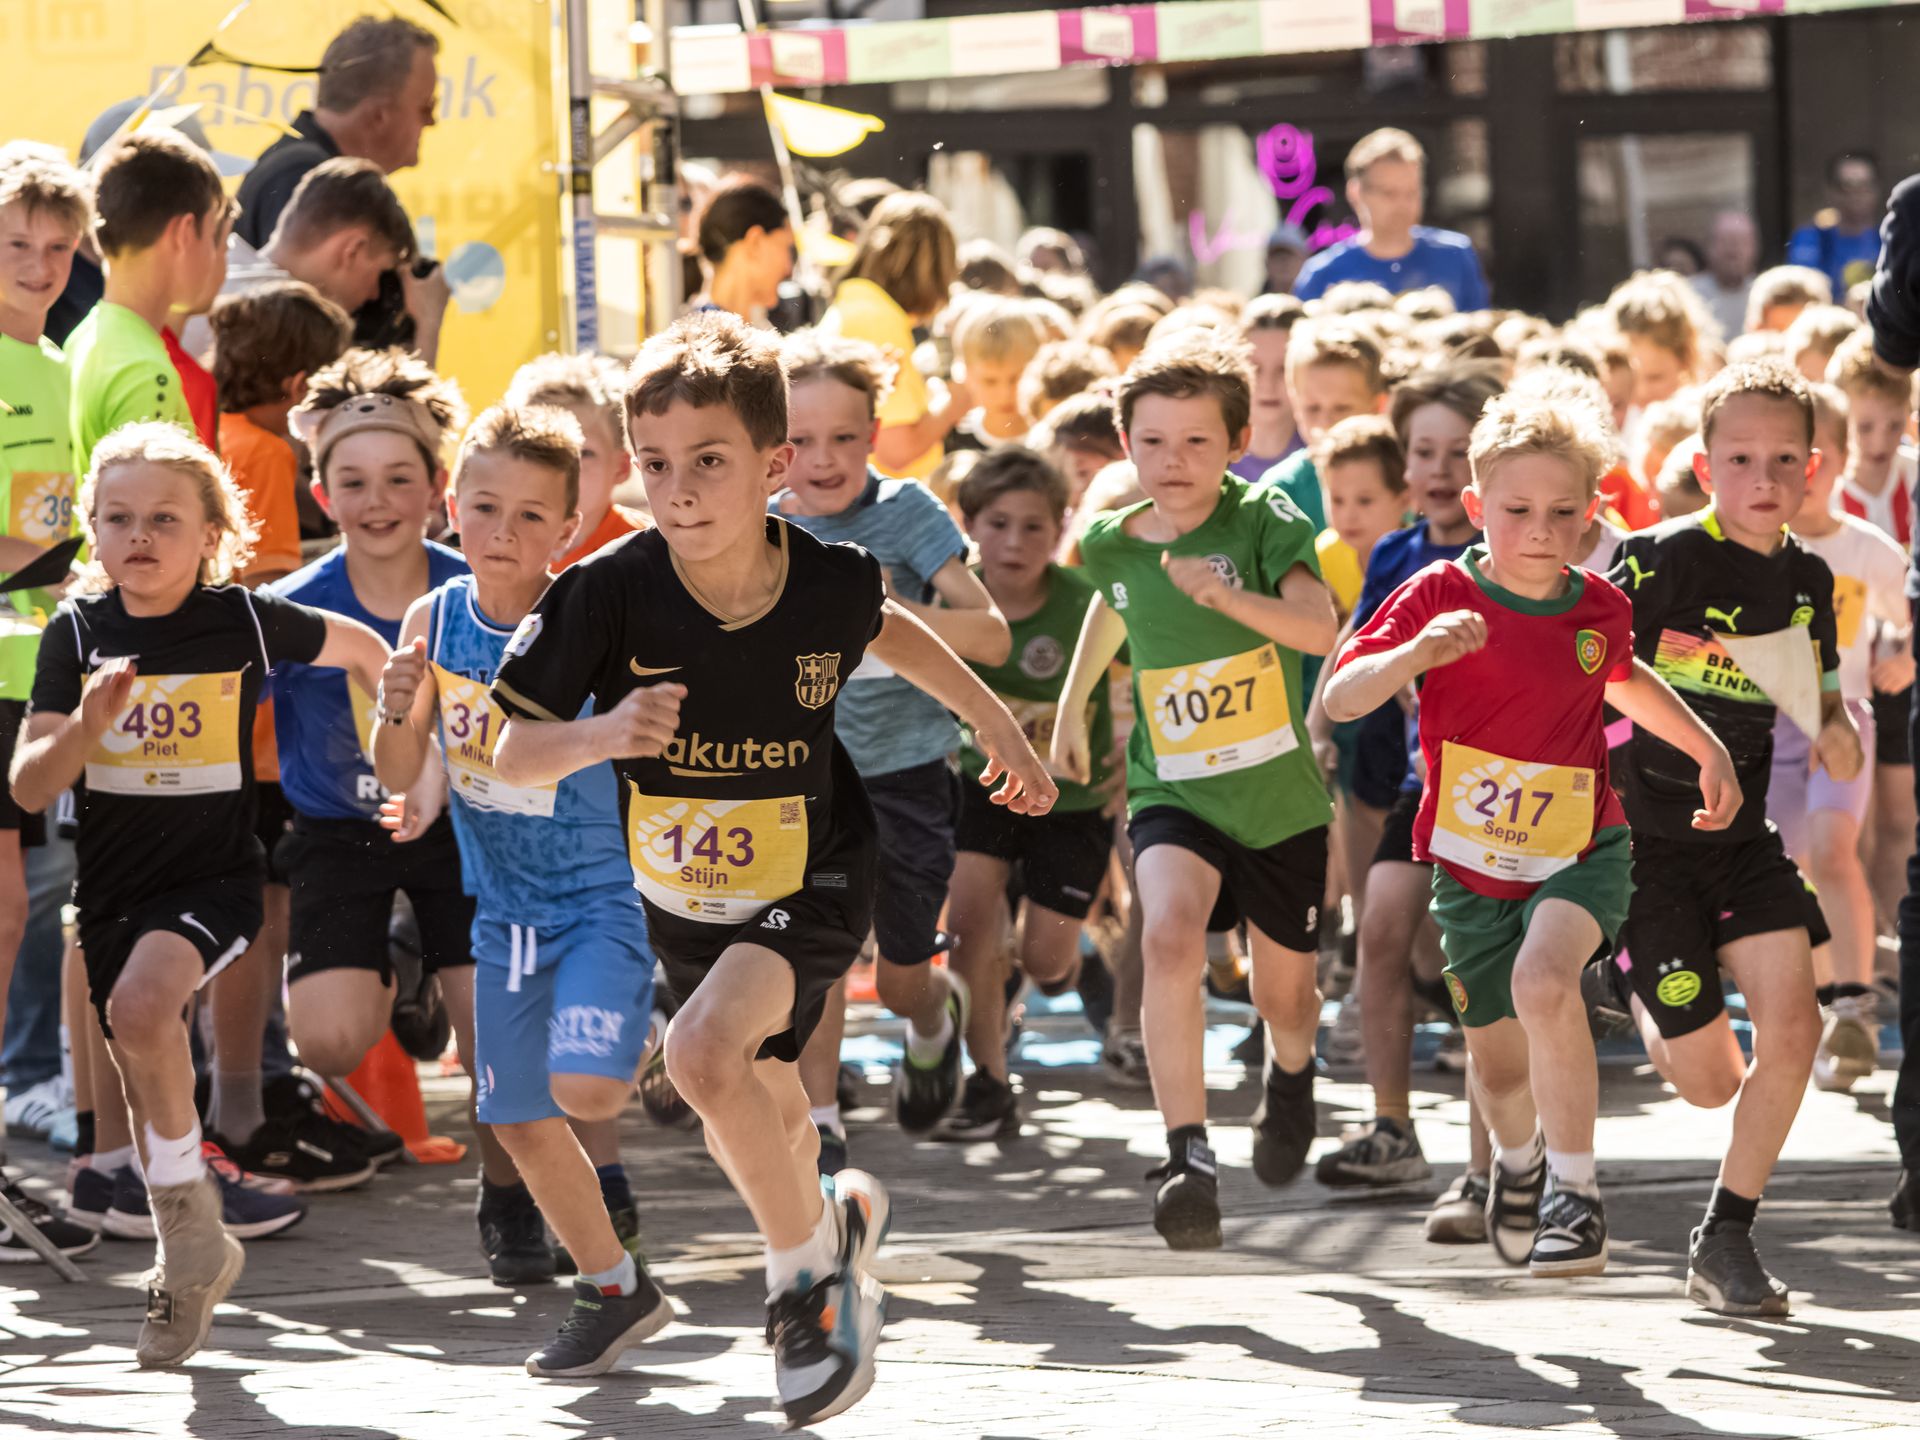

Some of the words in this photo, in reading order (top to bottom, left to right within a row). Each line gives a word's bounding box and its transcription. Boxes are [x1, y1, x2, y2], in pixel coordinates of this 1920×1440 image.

[1707, 652, 1741, 673] BR
[122, 701, 202, 739] 493
[1165, 676, 1256, 726] 1027
[450, 703, 508, 747] 31
[143, 741, 179, 756] Piet
[662, 732, 810, 770] akuten
[1475, 779, 1554, 827] 217
[663, 824, 755, 867] 143
[1483, 820, 1528, 846] Sepp
[680, 865, 728, 888] Stijn
